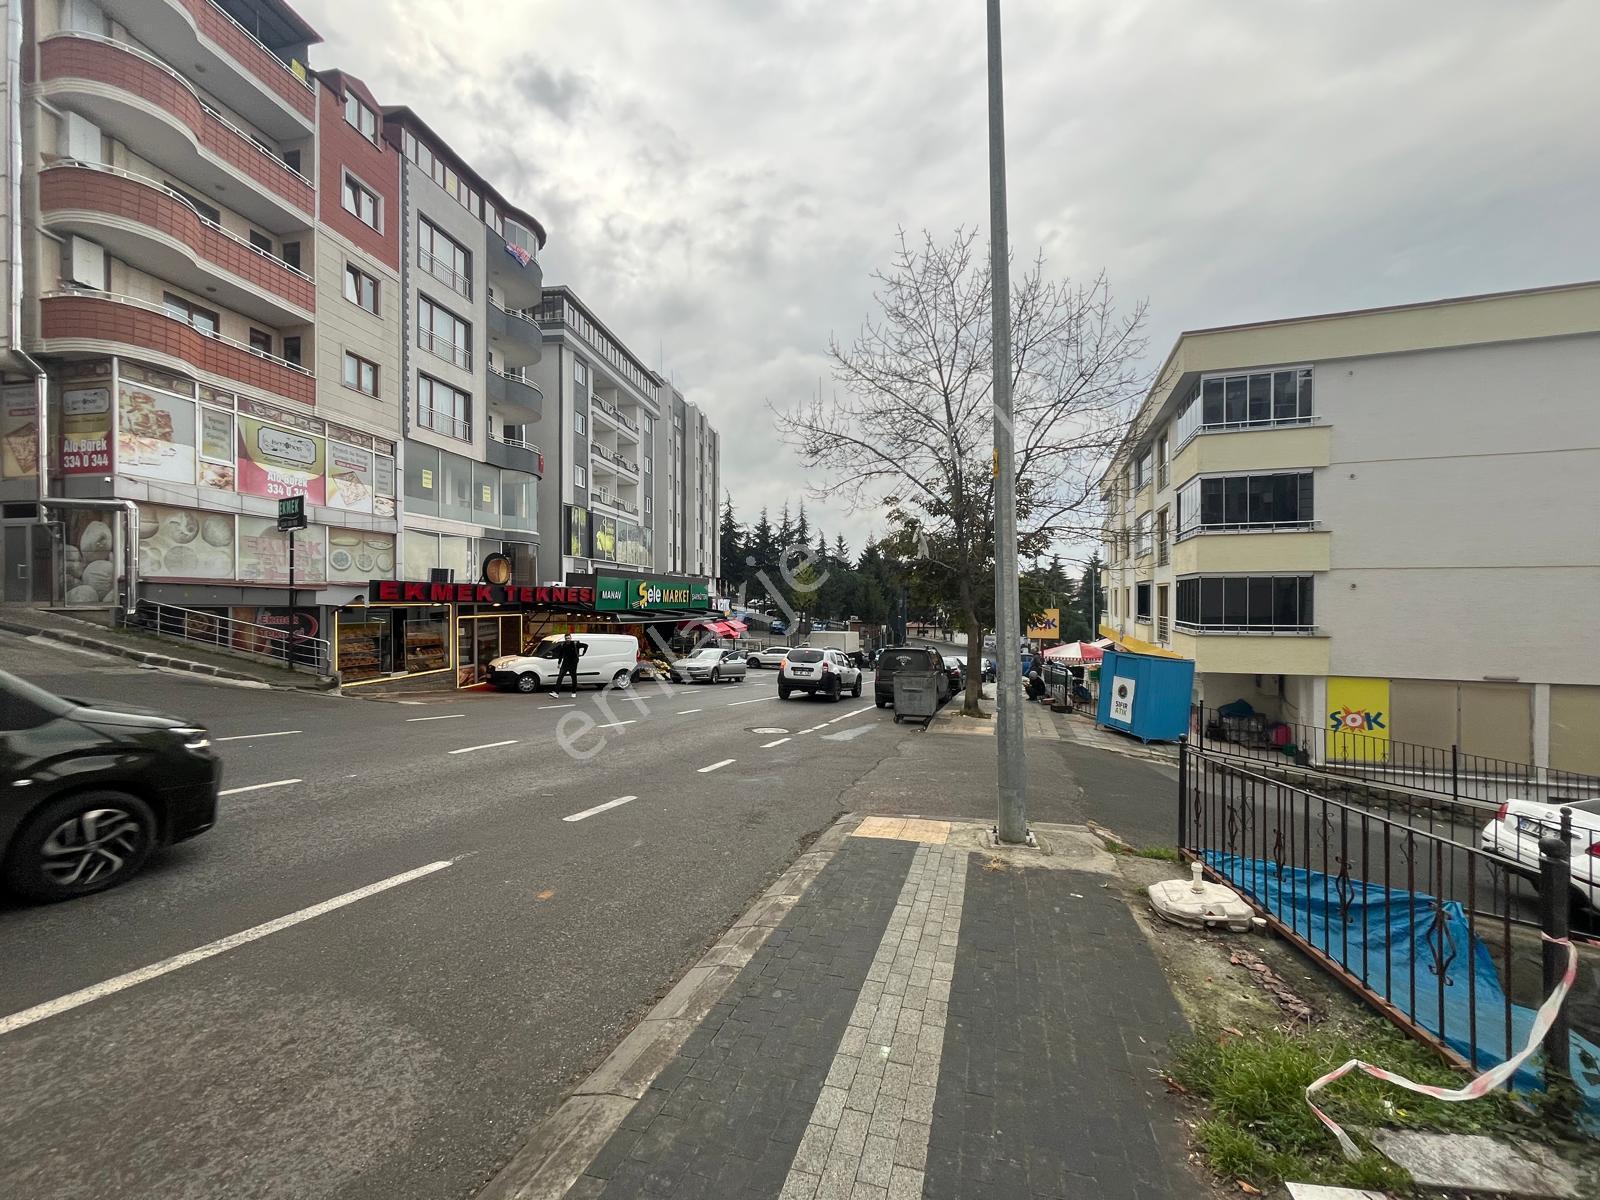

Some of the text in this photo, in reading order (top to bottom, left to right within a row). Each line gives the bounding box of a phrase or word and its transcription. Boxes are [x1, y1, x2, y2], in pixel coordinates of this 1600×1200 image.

[63, 455, 81, 468] 334
[91, 454, 109, 467] 344
[267, 483, 284, 496] 334
[279, 498, 300, 516] EKMEK
[379, 581, 493, 602] EKMEK
[601, 590, 622, 600] MANAV
[662, 589, 690, 603] MARKET
[1329, 709, 1386, 732] ŞOK
